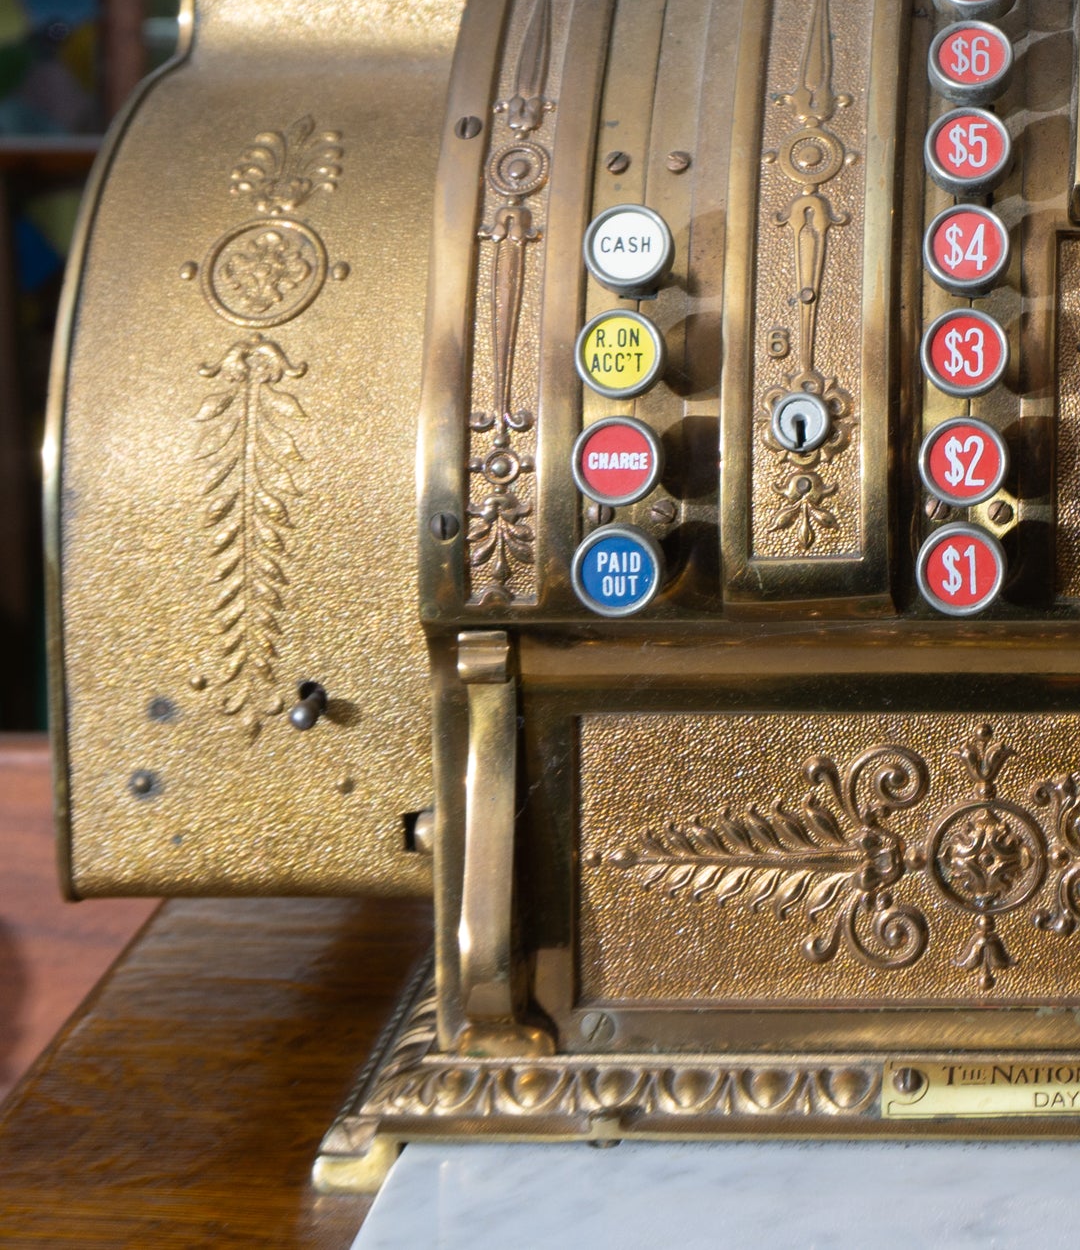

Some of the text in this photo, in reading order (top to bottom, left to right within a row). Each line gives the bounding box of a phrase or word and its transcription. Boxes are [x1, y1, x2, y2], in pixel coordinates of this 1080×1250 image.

[951, 36, 990, 76] $6
[948, 123, 988, 168] $5
[601, 236, 651, 253] CASH
[944, 223, 987, 270] $4
[767, 330, 789, 357] 6
[944, 328, 984, 377] $3
[590, 352, 643, 372] ACC'T
[588, 452, 648, 470] CHARGE
[944, 435, 984, 486] $2
[597, 552, 641, 573] PAID
[942, 545, 976, 595] $1
[602, 576, 637, 597] OUT
